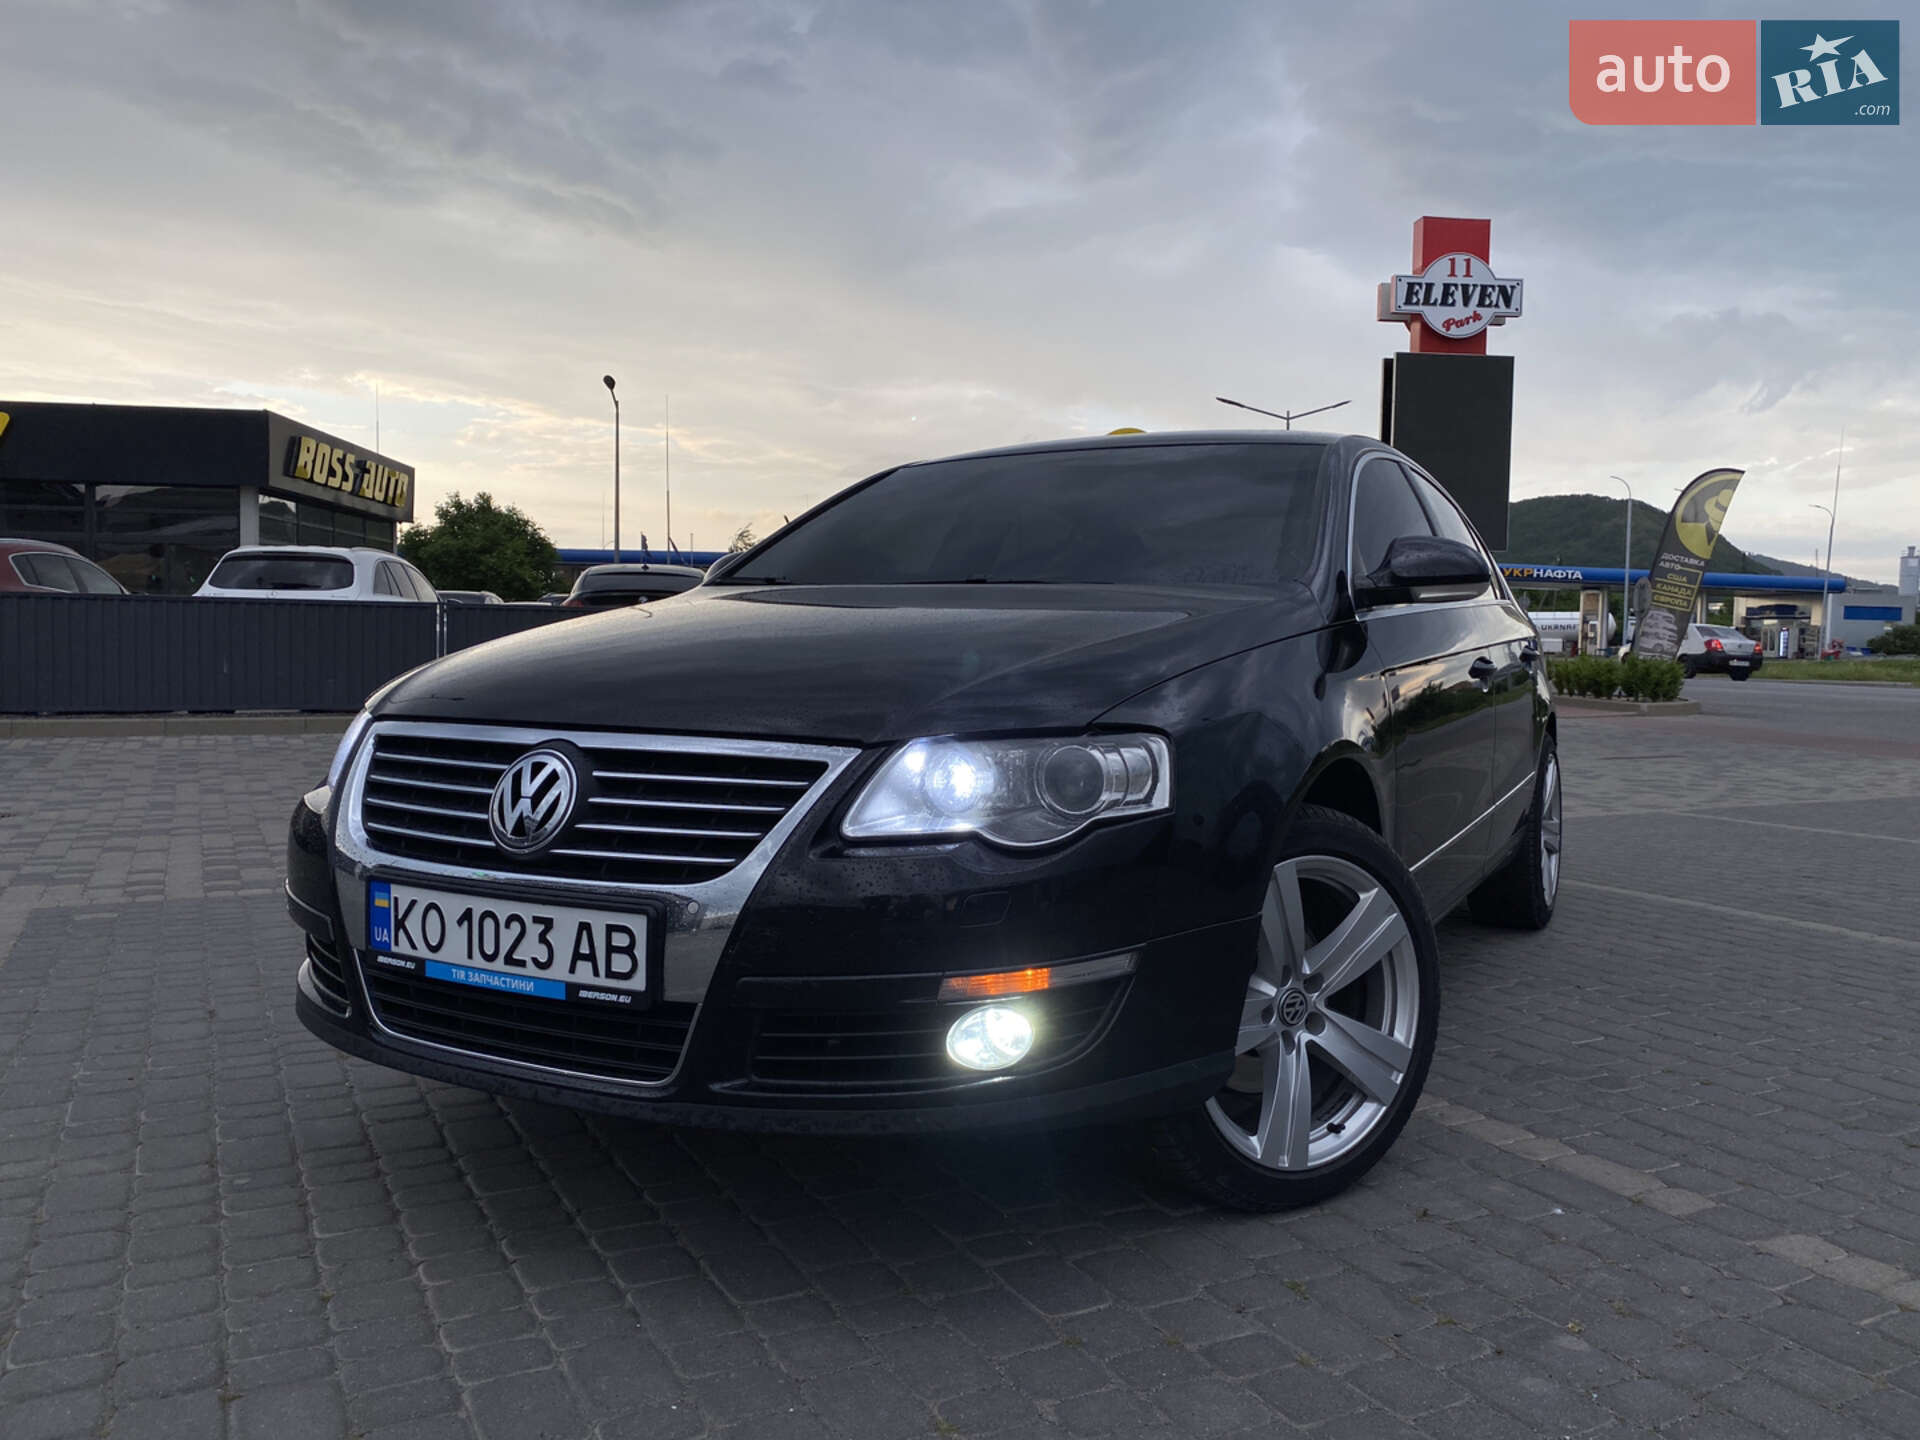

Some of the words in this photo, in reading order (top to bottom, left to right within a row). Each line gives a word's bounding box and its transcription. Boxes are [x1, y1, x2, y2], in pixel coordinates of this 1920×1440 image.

[1447, 257, 1473, 278] 11
[1403, 281, 1517, 309] ELEVEN
[1442, 310, 1483, 332] Park
[294, 436, 356, 493] BOSS
[1503, 567, 1583, 580] УКРНАФТА
[374, 925, 390, 944] UA
[393, 896, 446, 953] KO
[456, 906, 554, 970] 1023
[568, 920, 639, 981] AB
[467, 971, 535, 993] ЗАПЧАСТИНИ
